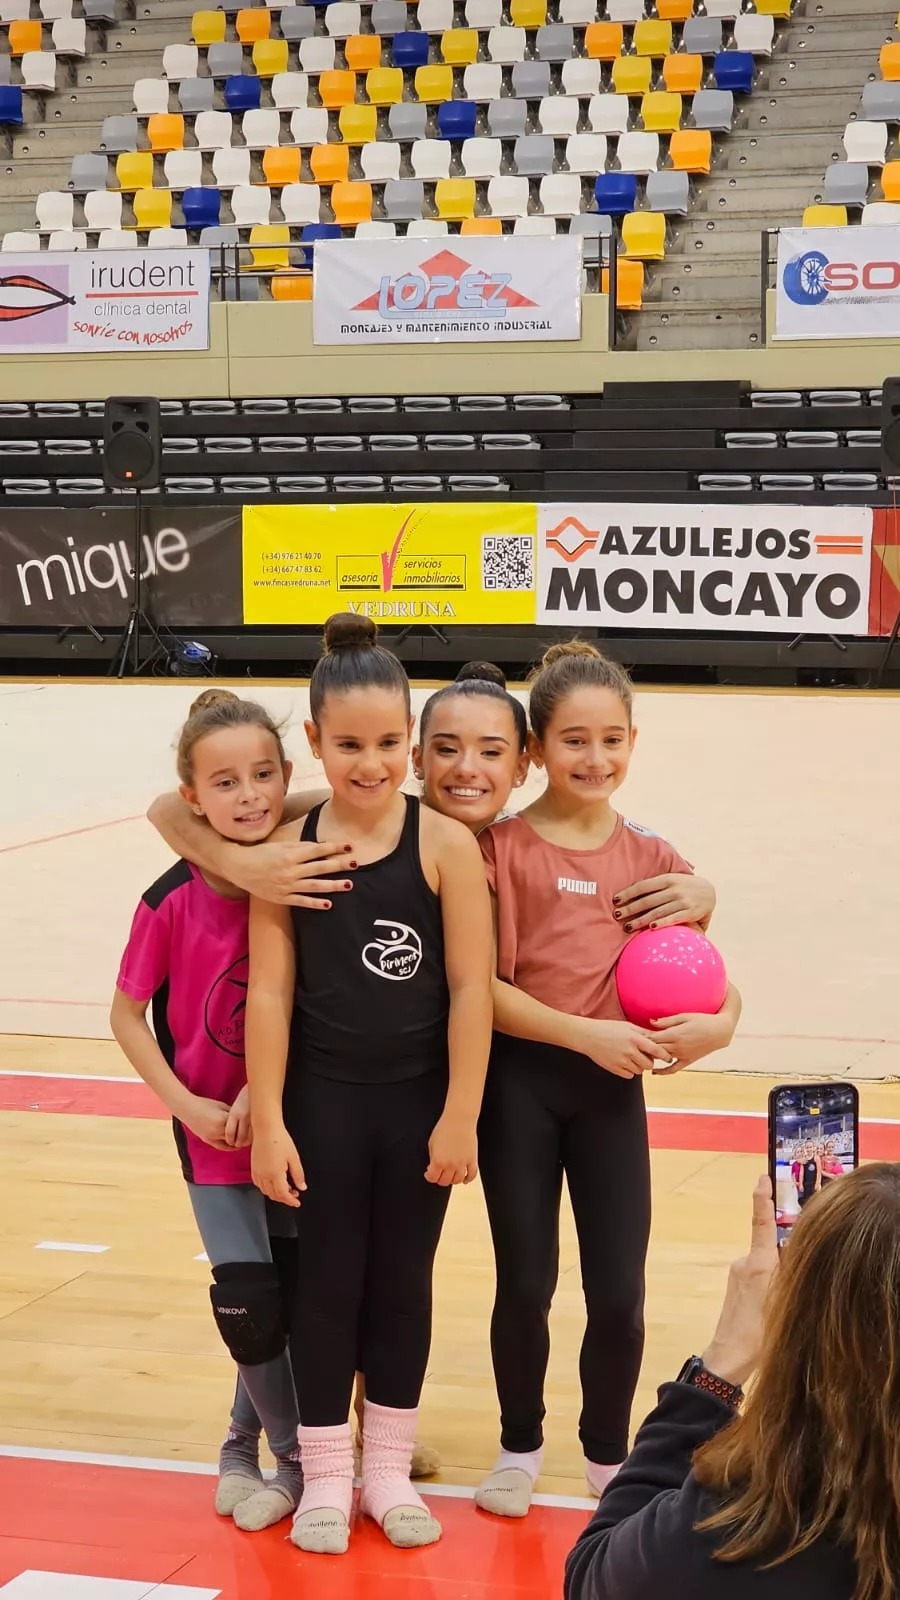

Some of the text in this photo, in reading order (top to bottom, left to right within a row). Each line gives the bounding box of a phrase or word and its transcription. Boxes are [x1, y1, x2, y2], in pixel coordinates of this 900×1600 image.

[90, 259, 195, 289] irudent
[378, 272, 512, 319] LOPEZ
[94, 299, 192, 317] clínica dental
[73, 320, 193, 346] sonríe con nosotros
[340, 320, 552, 334] MONTAJES Y MANTENIMIENTO INDUSTRIAL
[599, 525, 811, 560] AZULEJOS
[261, 552, 322, 561] (+34) 976 21 40 70
[403, 557, 442, 569] servicios
[16, 527, 190, 606] mique
[262, 565, 322, 574] (+34) 667 47 83 62
[403, 572, 461, 584] inmobiliarios
[545, 567, 861, 620] MONCAYO
[347, 600, 457, 617] VEDRUNA
[557, 877, 597, 895] PUMA
